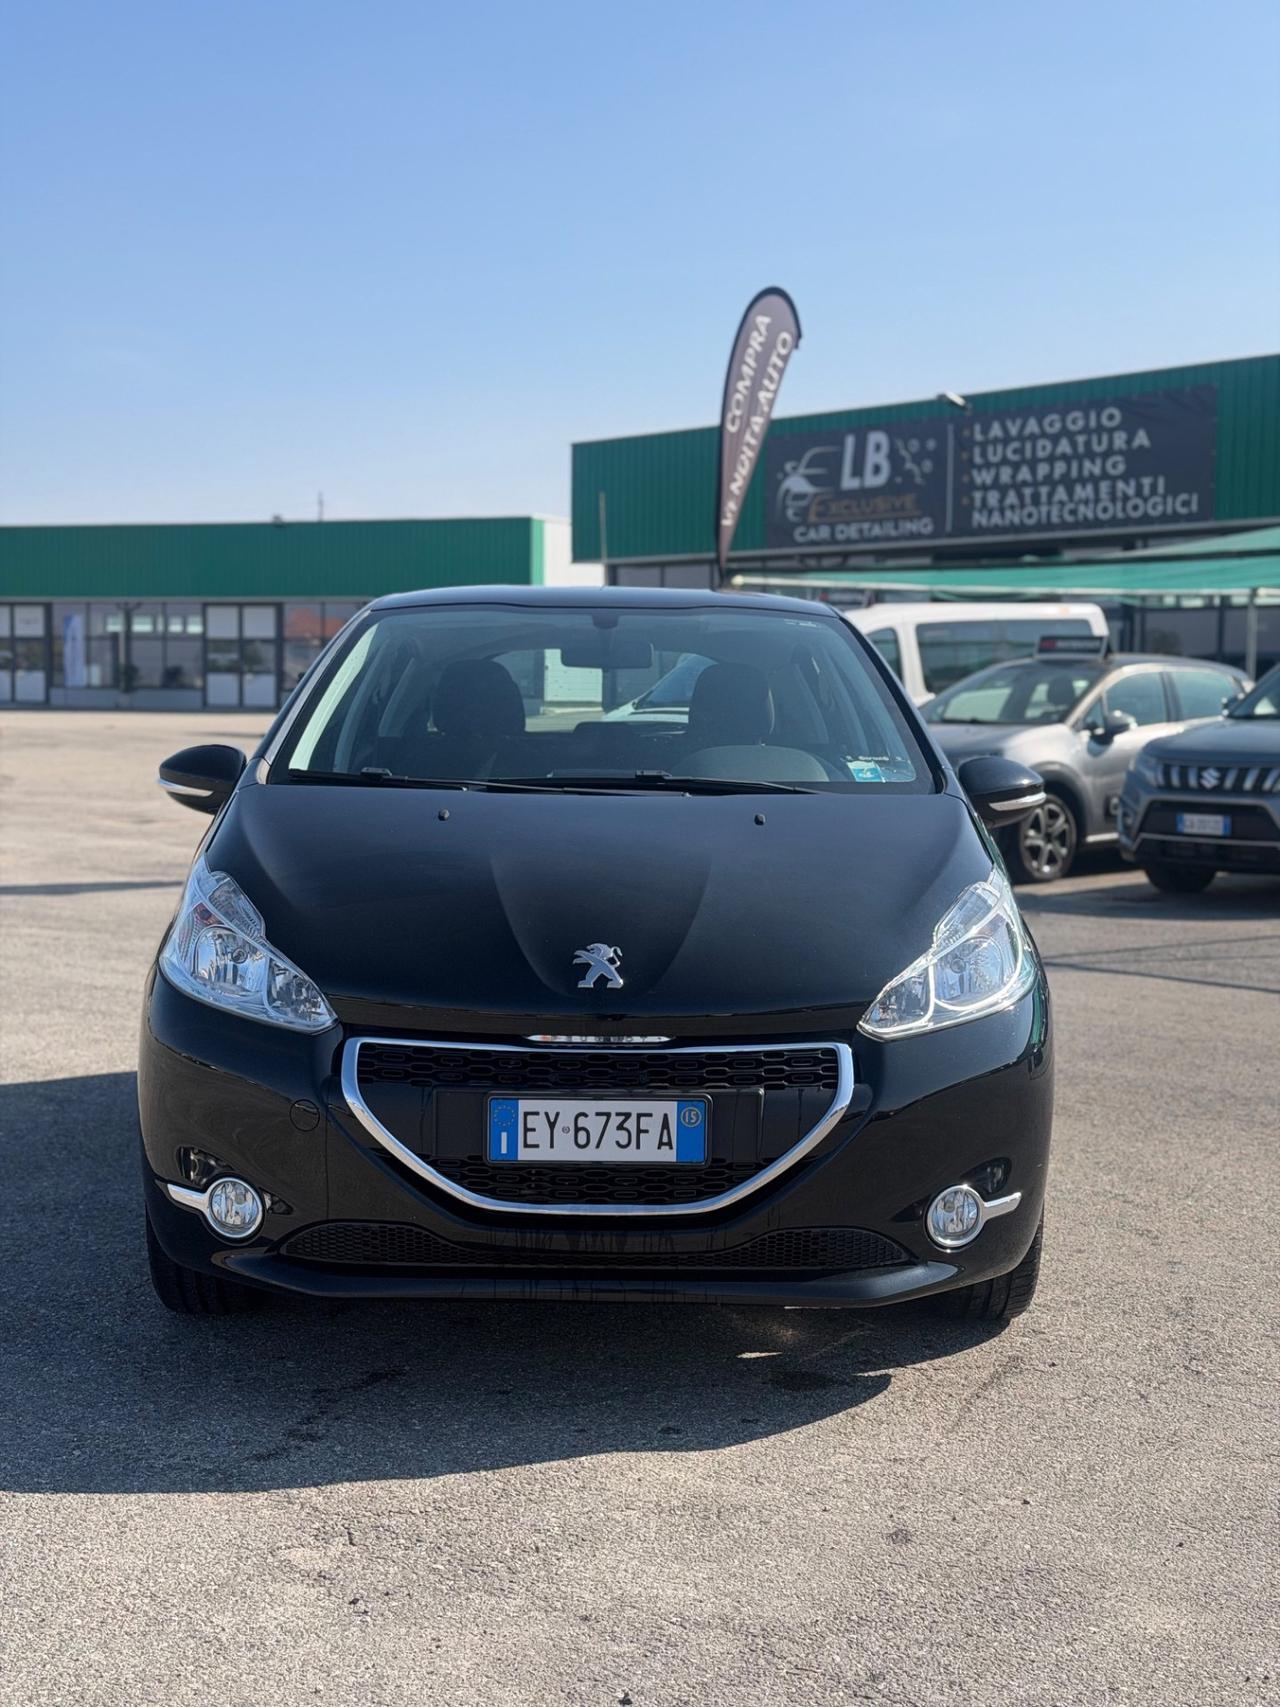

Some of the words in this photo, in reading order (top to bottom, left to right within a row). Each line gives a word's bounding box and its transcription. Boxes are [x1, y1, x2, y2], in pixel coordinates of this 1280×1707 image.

[726, 314, 772, 433] COMPRA
[756, 331, 793, 413] AUTO
[973, 406, 1122, 442] LAVAGGIO
[840, 430, 891, 490] LB
[973, 428, 1151, 465] LUCIDATURA
[972, 454, 1126, 486] WRAPPING
[972, 475, 1165, 509] TRATTAMENTI
[972, 493, 1198, 528] NANOTECNOLOGICI
[793, 524, 831, 543] CAR
[834, 516, 934, 541] DETAILING
